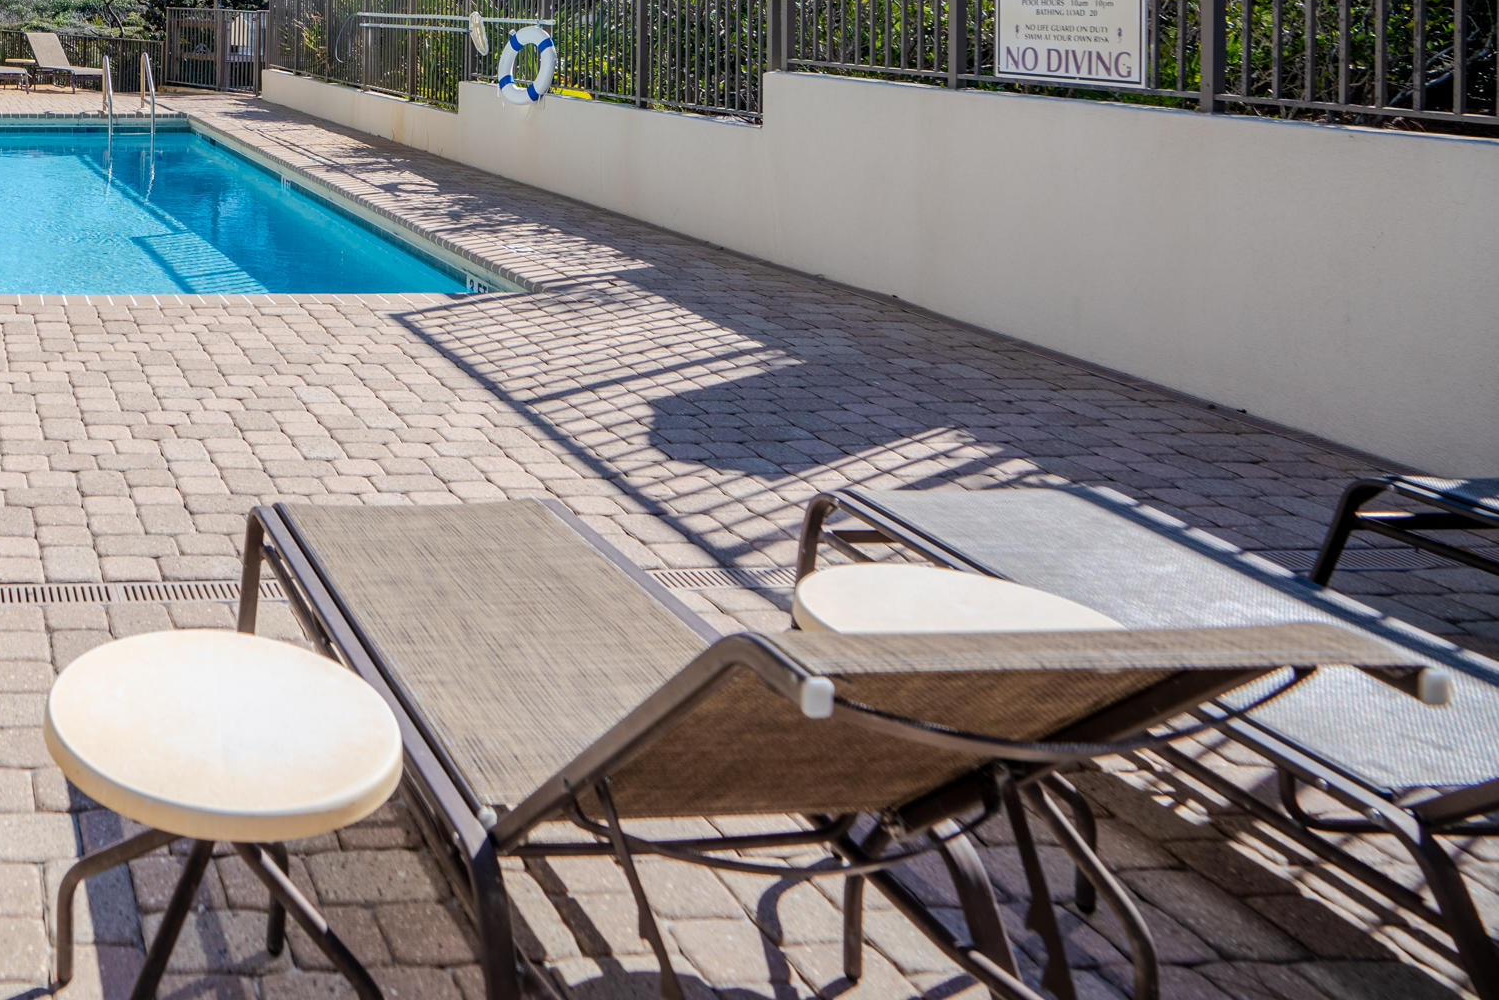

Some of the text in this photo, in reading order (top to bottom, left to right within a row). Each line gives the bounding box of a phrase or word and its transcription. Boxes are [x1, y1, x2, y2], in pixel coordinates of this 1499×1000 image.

[1095, 0, 1115, 9] 10pm
[1035, 8, 1064, 16] BATHING
[1089, 9, 1098, 17] 20
[1025, 24, 1109, 34] NO LIFE GUARD ON DUTY
[1024, 33, 1042, 41] SWIM
[1053, 34, 1073, 42] YOUR
[1074, 35, 1092, 43] OWN
[1005, 45, 1132, 79] NO DIVING
